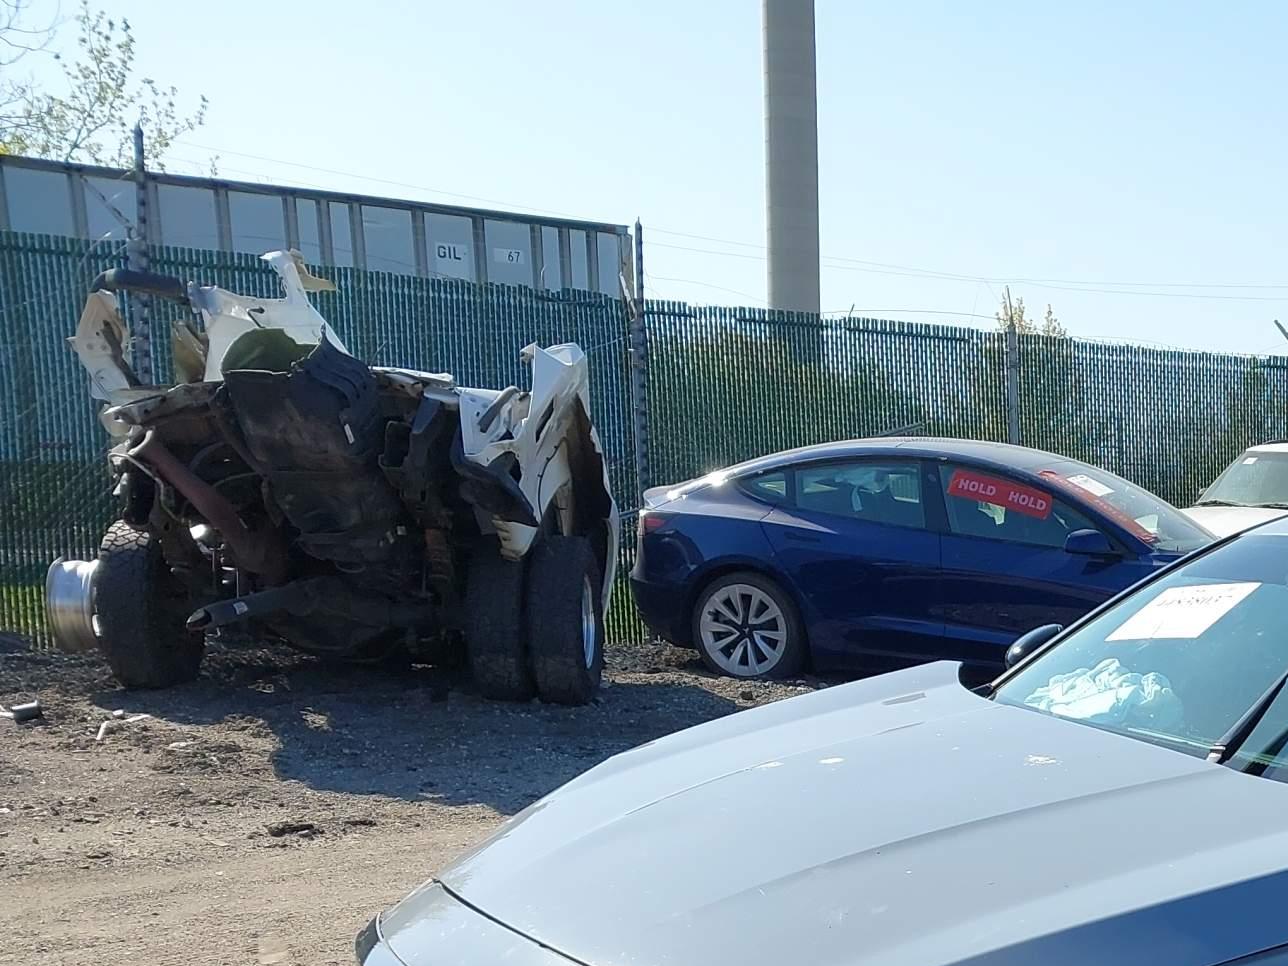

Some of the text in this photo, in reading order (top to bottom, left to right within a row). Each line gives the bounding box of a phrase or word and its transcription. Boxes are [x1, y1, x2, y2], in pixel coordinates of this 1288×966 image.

[437, 245, 520, 263] GIL 67
[958, 478, 1047, 511] HOLD HOLD
